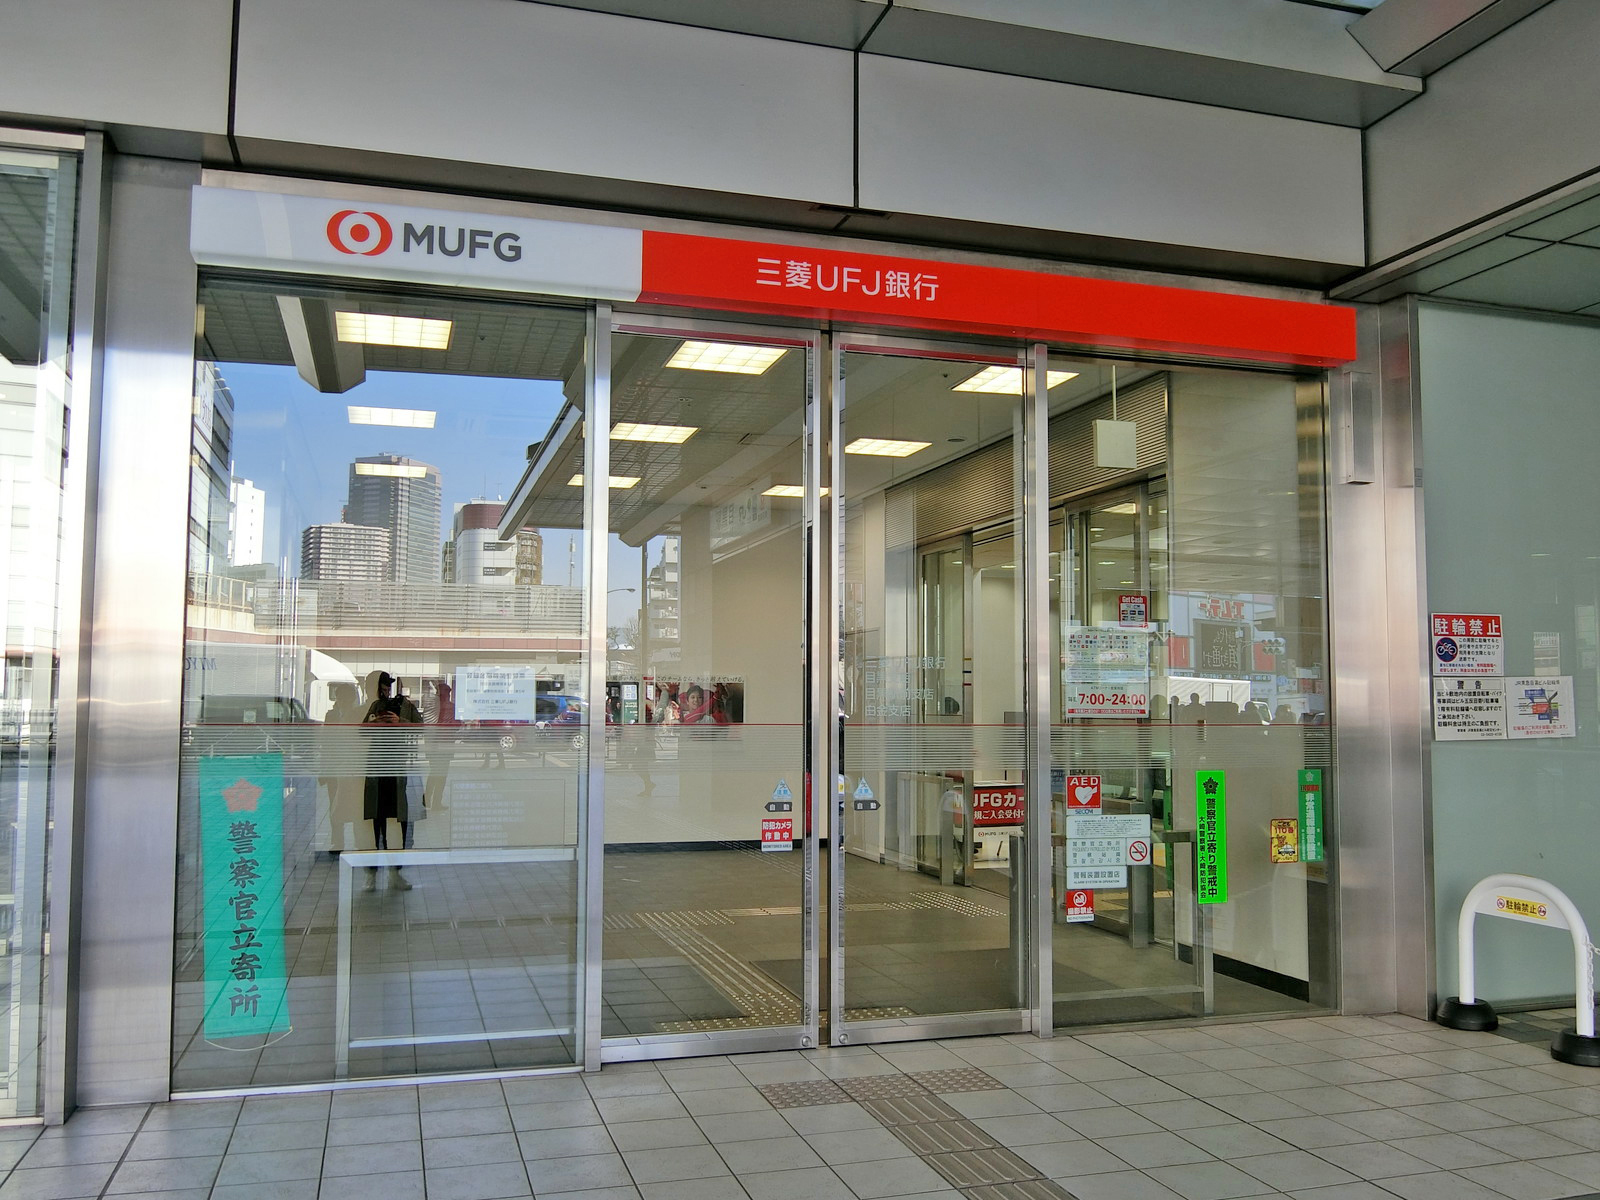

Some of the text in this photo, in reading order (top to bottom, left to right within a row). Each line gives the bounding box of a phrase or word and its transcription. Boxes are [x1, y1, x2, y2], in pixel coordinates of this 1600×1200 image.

[403, 222, 522, 263] MUFG
[755, 256, 939, 302] 三菱UFJ銀行
[1434, 618, 1501, 636] 駐輪禁止
[865, 703, 911, 717] 白金支店
[1069, 777, 1099, 786] AED
[762, 821, 793, 830] 防犯カメラ
[764, 831, 790, 841] 作動中
[1206, 798, 1218, 897] 警察官立寄り警戒中
[1505, 900, 1537, 915] 駐輪禁止
[226, 819, 265, 1018] 警察官立寄所
